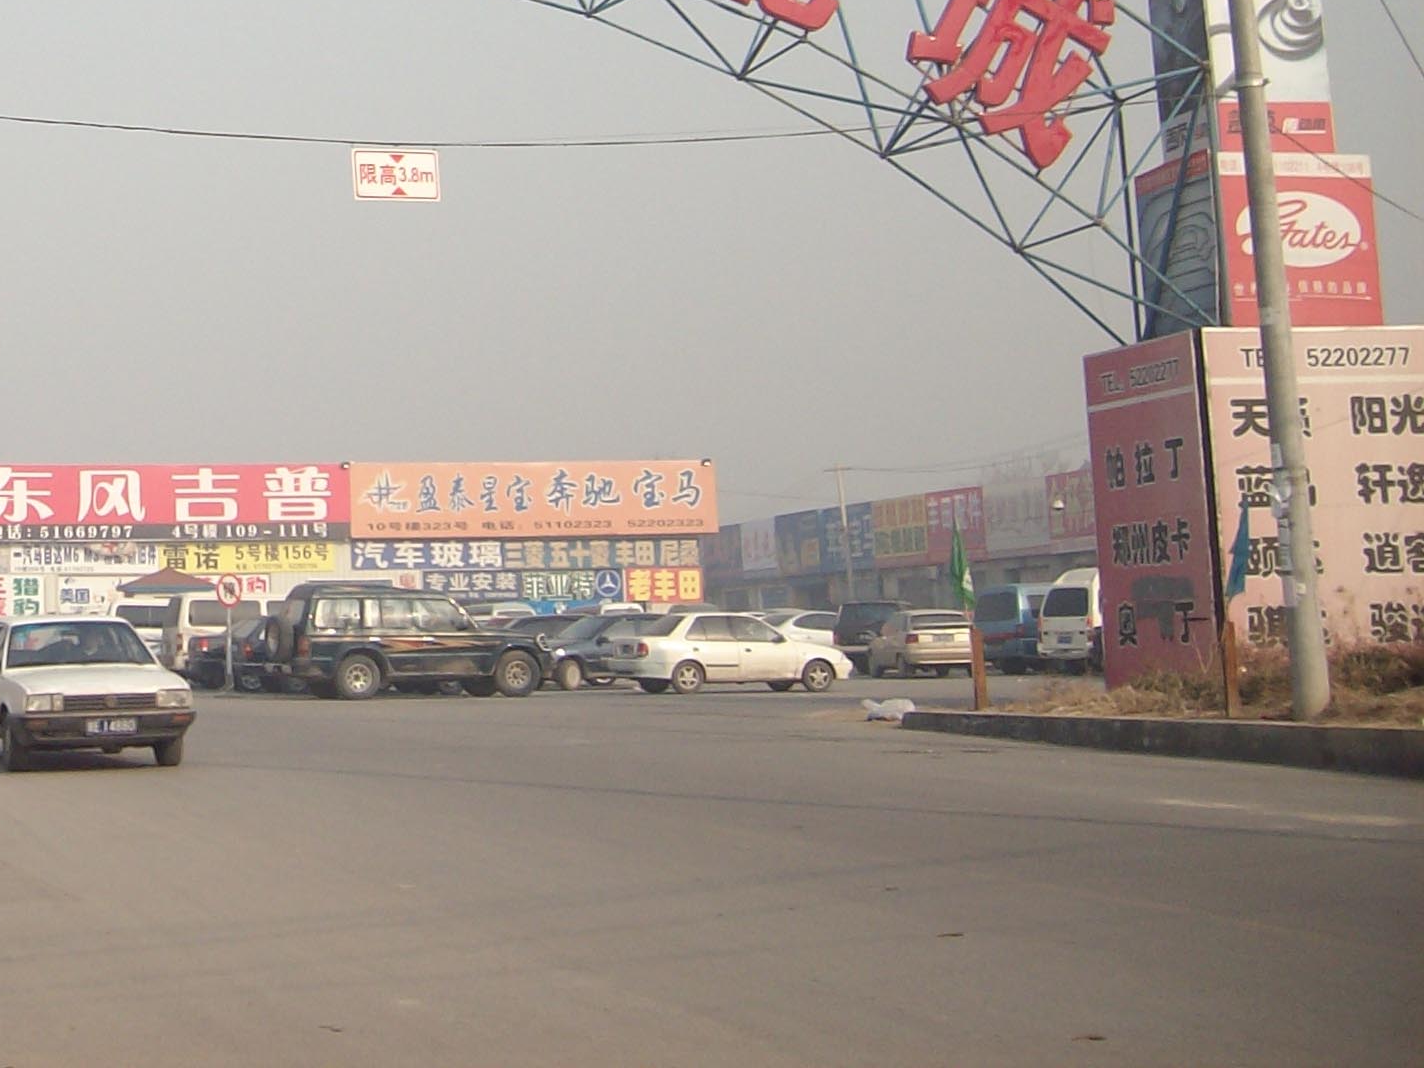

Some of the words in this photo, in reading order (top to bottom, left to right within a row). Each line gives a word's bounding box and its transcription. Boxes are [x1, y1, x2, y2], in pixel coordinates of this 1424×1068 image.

[359, 163, 434, 185] 限高3.8m
[1307, 347, 1410, 367] 52202277
[546, 468, 621, 514] 奔驰
[633, 469, 700, 508] 宝马
[39, 525, 134, 540] 51669797
[163, 544, 220, 570] 雷诺
[235, 543, 329, 562] 5号楼156号
[354, 540, 503, 569] 汽车玻璃
[426, 572, 519, 592] 专业安装
[629, 568, 702, 602] 老丰田
